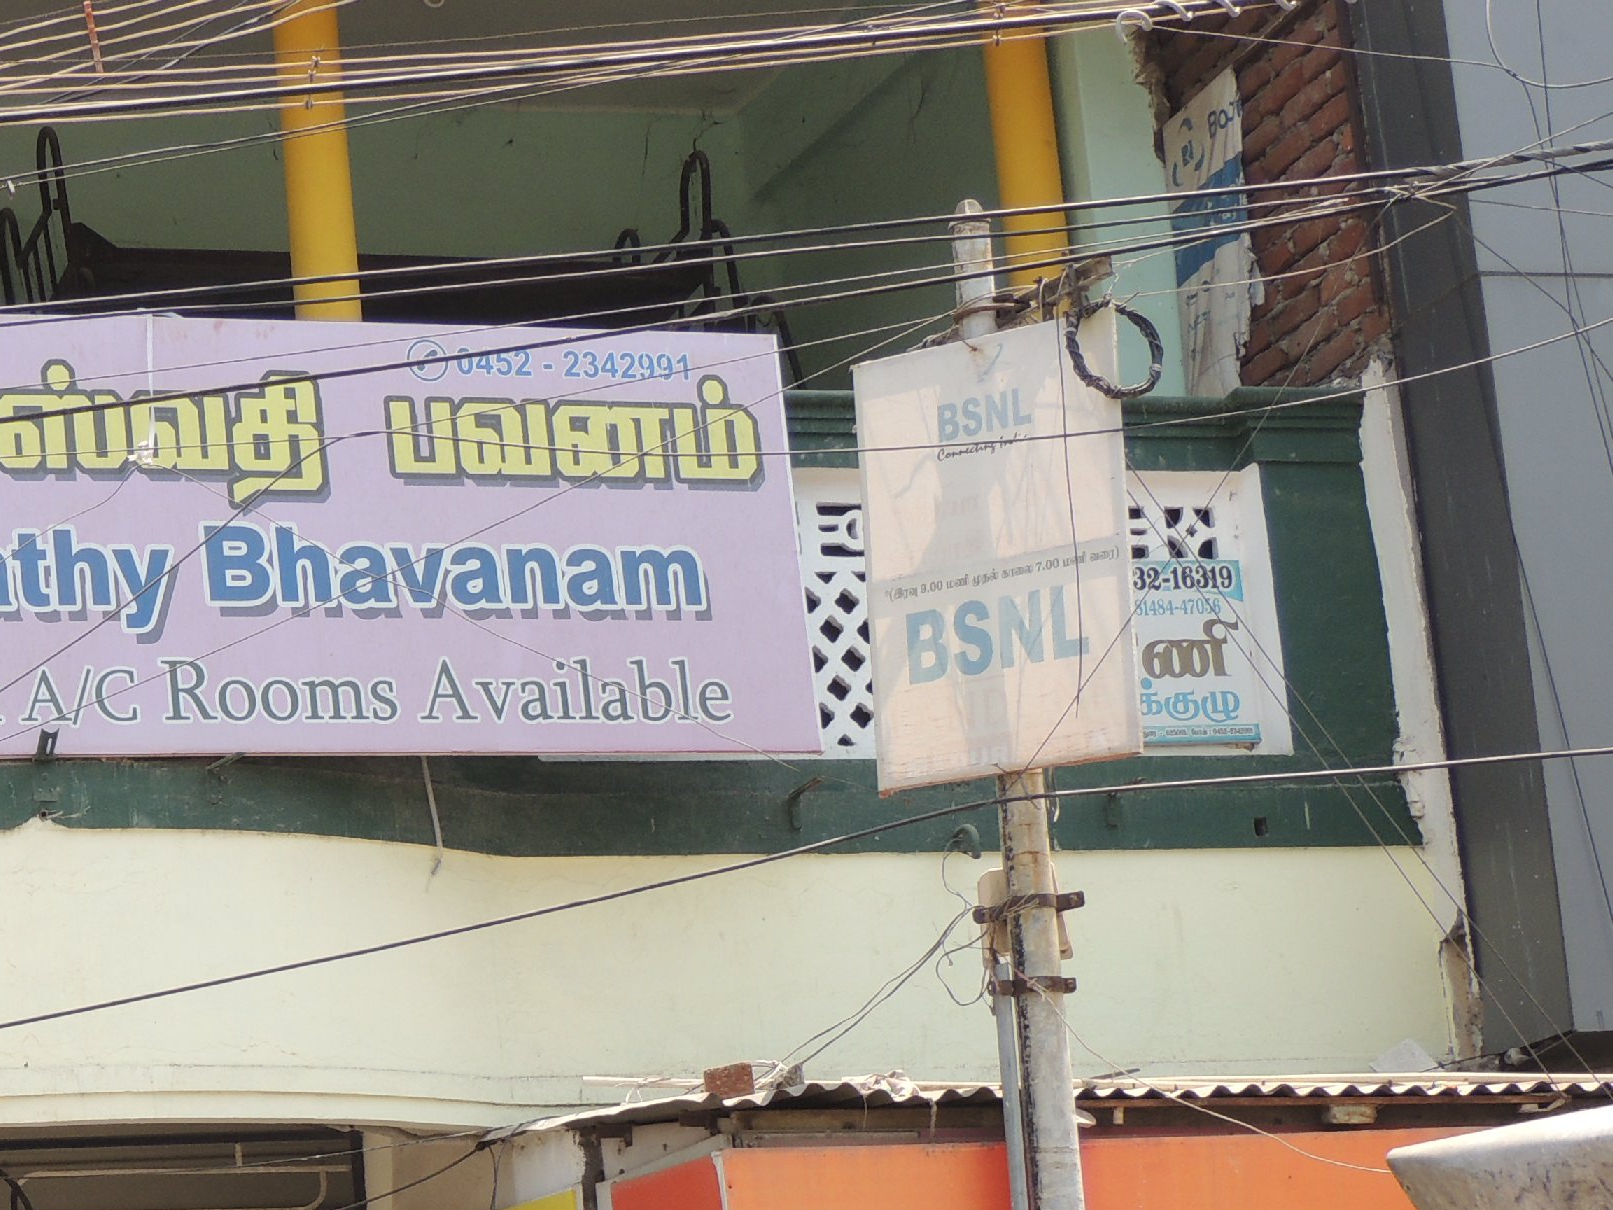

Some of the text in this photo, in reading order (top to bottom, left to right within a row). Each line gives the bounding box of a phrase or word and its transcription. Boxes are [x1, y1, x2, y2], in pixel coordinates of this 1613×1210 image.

[456, 347, 533, 377] 0452
[562, 349, 691, 381] 2342991
[385, 374, 764, 494] பவனம்
[937, 387, 1033, 443] BSNL
[202, 520, 708, 618] Bhavanam
[905, 581, 1090, 687] BSNL
[26, 664, 143, 730] A/C
[160, 658, 400, 727] Rooms
[427, 655, 734, 728] Available
